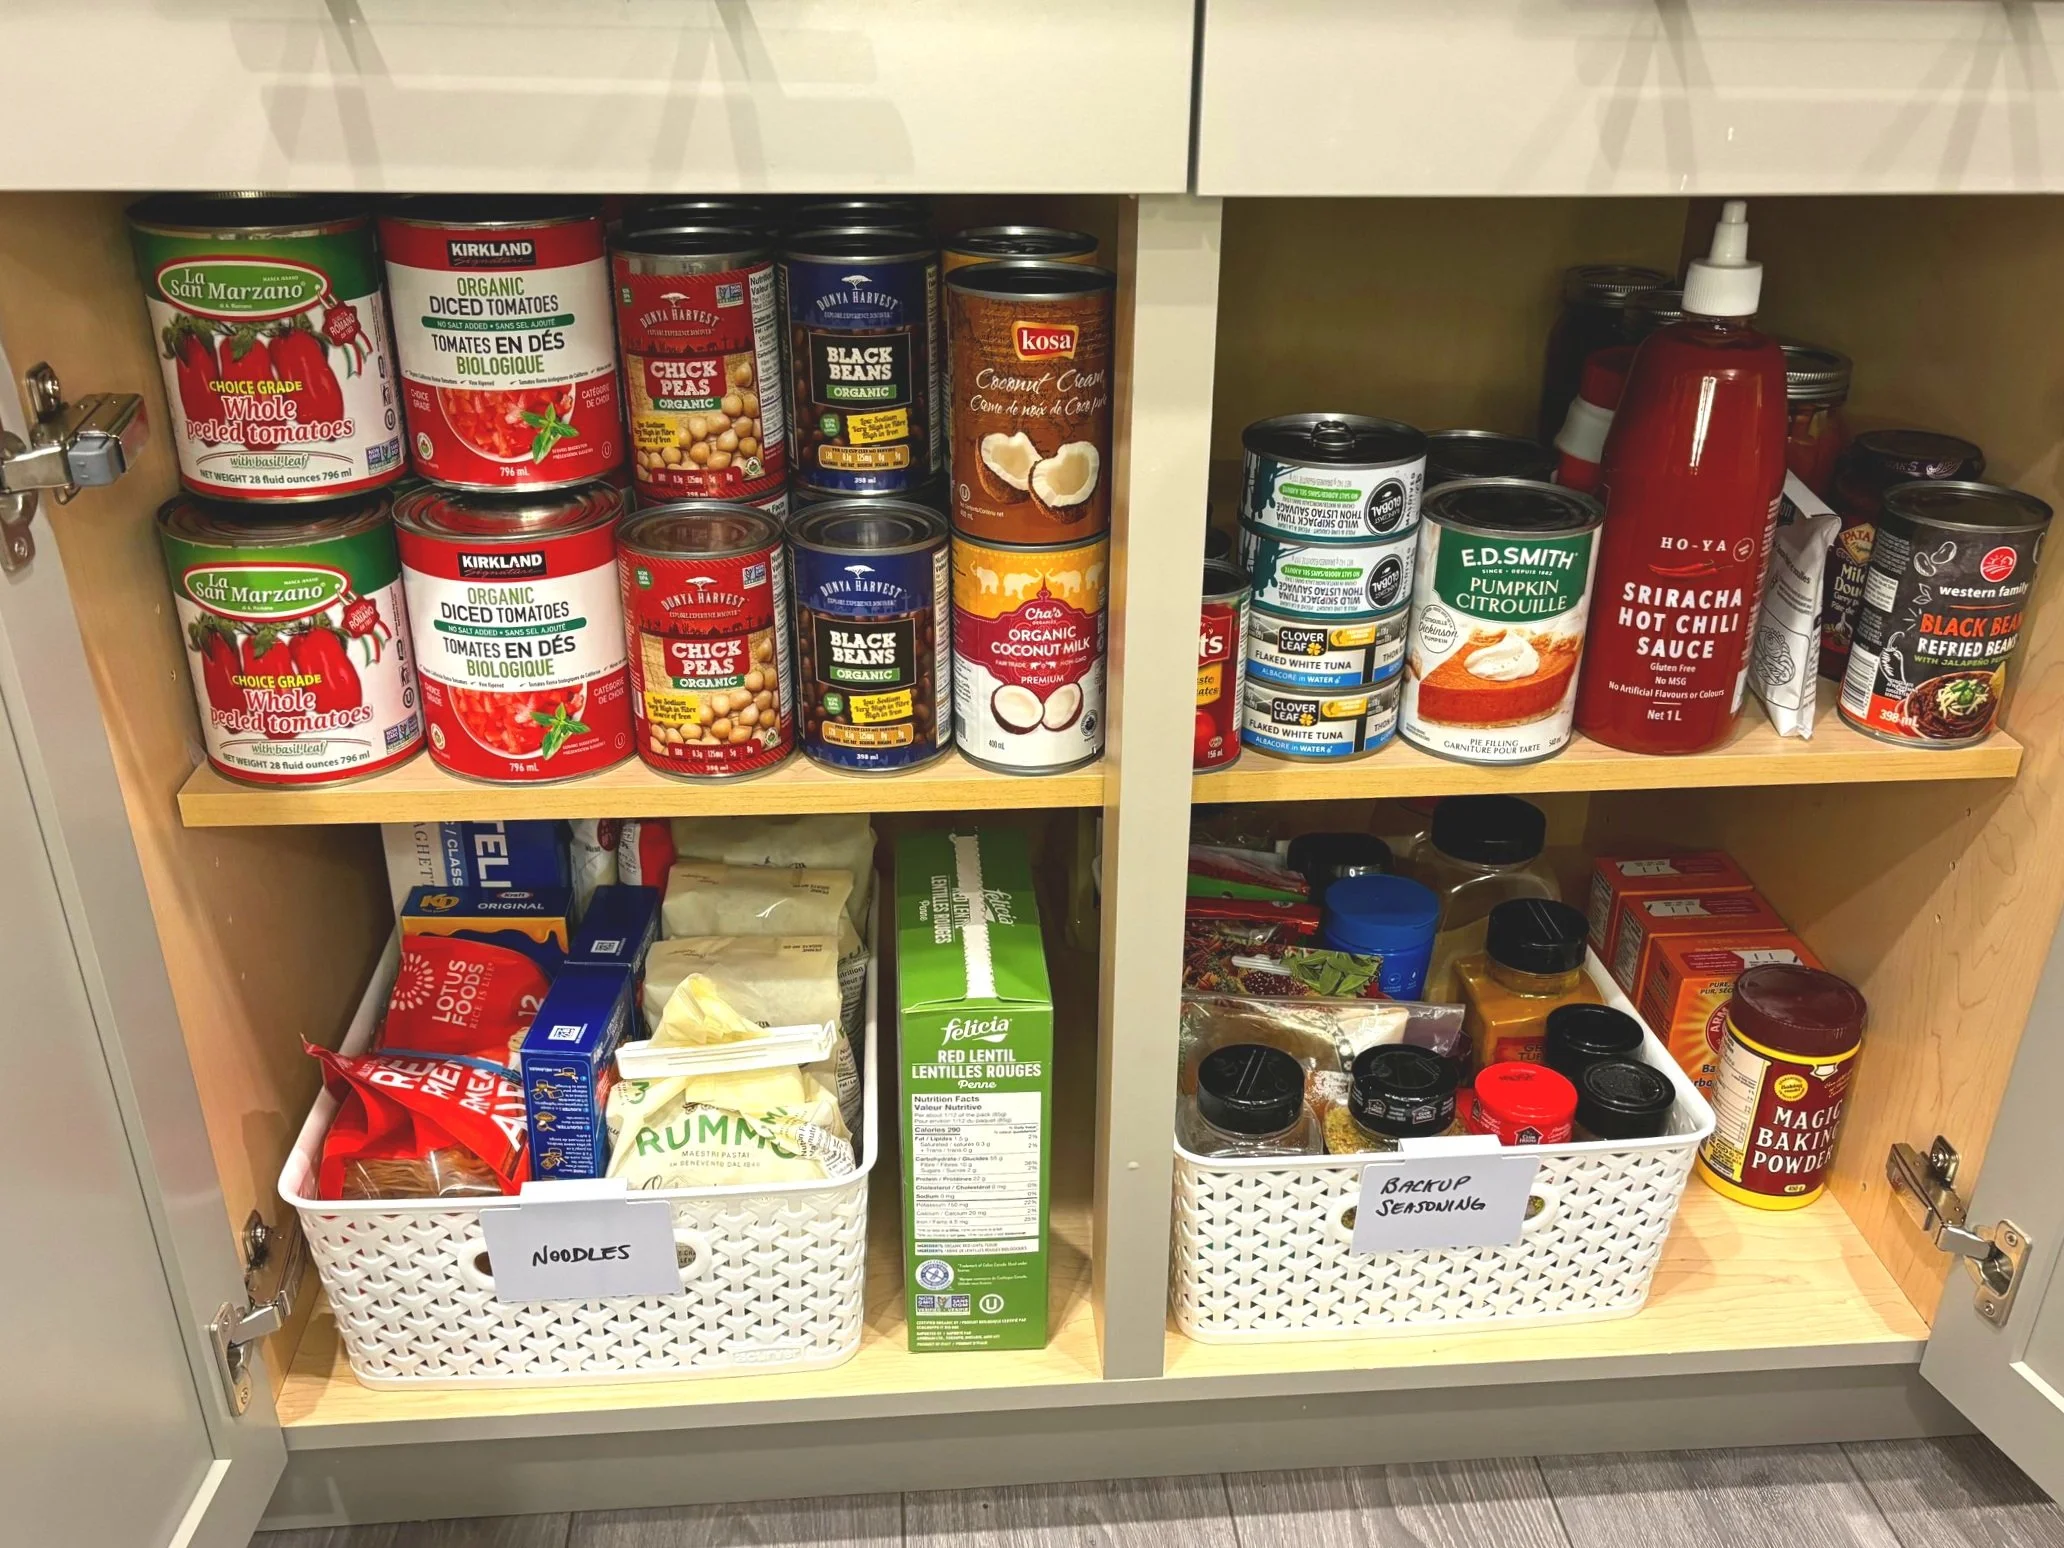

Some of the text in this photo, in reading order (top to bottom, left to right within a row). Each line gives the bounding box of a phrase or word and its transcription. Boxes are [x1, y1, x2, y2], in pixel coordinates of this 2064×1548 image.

[451, 243, 532, 256] KIRKLAND
[184, 269, 205, 284] La
[171, 280, 303, 300] San Marzano
[457, 277, 524, 297] ORGANIC
[430, 295, 558, 316] DICED TOMATOES
[432, 330, 565, 353] TOMATES EN DÉS
[1022, 330, 1071, 350] kosa
[826, 347, 892, 364] BLACK
[456, 355, 544, 375] BIOLOGIQUE
[650, 360, 718, 379] CHICK
[830, 364, 892, 381] BEANS
[209, 381, 303, 394] CHOICE GRADE
[661, 379, 710, 396] PEAS
[976, 368, 1104, 394] Coconut Cream
[834, 388, 889, 398] ORGANIC
[222, 396, 297, 421] Whole
[659, 399, 714, 410] ORGANIC
[187, 419, 354, 444] peeled tomatoes
[1277, 502, 1361, 519] THON LISTAO SAUVAGE
[1371, 496, 1401, 516] GLOBAL
[1276, 512, 1358, 528] WILD SKIPJACK TUNA
[462, 554, 542, 569] KIRKLAND
[1462, 547, 1575, 570] E.D.SMITH
[209, 574, 228, 588] La
[820, 581, 902, 598] DUNYA HARVEST
[1470, 577, 1559, 596] PUMPKIN
[1940, 582, 2029, 598] western family
[196, 583, 323, 602] San Marzano
[467, 587, 534, 605] ORGANIC
[661, 591, 745, 611] DUNYA HARVEST
[1623, 582, 1742, 609] SRIRACHA
[441, 601, 570, 623] DICED TOMATOES
[1456, 593, 1567, 614] CITROUILLE
[1025, 607, 1063, 620] Cha's
[1618, 607, 1739, 634] HOT CHILI
[458, 625, 473, 635] SALT
[475, 628, 498, 636] ADDED
[523, 627, 538, 635] SEL
[1009, 626, 1076, 641] ORGANIC
[1419, 621, 1458, 639] Dickinson
[1920, 614, 1988, 637] BLACK
[830, 630, 896, 649] BLACK
[1281, 631, 1324, 642] CLOVER
[1917, 633, 2018, 657] REFRIED BEANS
[443, 635, 576, 659] TOMATES EN DÉS
[672, 640, 742, 659] CHICK
[991, 636, 1090, 657] COCONUT MILK
[1281, 642, 1306, 651] LEAF
[1636, 637, 1714, 659] SAUCE
[833, 649, 895, 665] BEANS
[1255, 650, 1352, 669] FLAKED WHITE TUNA
[1914, 655, 1989, 666] WITH JALAPEÑO
[467, 659, 555, 678] BIOLOGIQUE
[683, 659, 735, 676] PEAS
[837, 669, 893, 680] ORGANIC
[1262, 668, 1297, 681] ALBACORE
[1307, 675, 1333, 684] WATER
[1650, 662, 1696, 673] Gluten Free
[232, 674, 322, 688] CHOICE GRADE
[680, 677, 738, 688] ORGANIC
[1021, 675, 1064, 684] PREMIUM
[1655, 676, 1686, 686] No MSG
[1609, 681, 1619, 690] No
[1620, 684, 1653, 697] Artificial
[1655, 689, 1688, 699] Flavours
[1699, 688, 1725, 698] Colours
[244, 688, 315, 712] Whole
[210, 705, 372, 733] peeled tomatoes
[1647, 709, 1682, 721] Net 1 L
[1879, 709, 1919, 727] 398 mL
[251, 743, 274, 754] with
[1444, 741, 1540, 754] GARNITURE POUR TARTE
[1470, 738, 1519, 748] PIE FILLING
[223, 751, 370, 769] NET WEIGHT 28 fluid ounces 796 ml
[510, 763, 525, 772] 796
[477, 902, 544, 910] ORIGINAL
[432, 960, 466, 1023] LOTUS
[451, 964, 484, 1026] FOODS
[1710, 1007, 1729, 1032] ARM
[941, 1016, 1012, 1046] felicia
[938, 1049, 1016, 1062] RED LENTIL
[912, 1064, 1041, 1079] LENTILLES ROUGES
[957, 1079, 996, 1089] Penne
[1773, 1099, 1842, 1130] MAGIC
[1756, 1121, 1840, 1151] BAKING
[681, 1150, 719, 1158] MAESTRI
[1751, 1144, 1833, 1173] POWDER
[1380, 1176, 1471, 1195] BACKUP
[1375, 1196, 1486, 1217] SEASONING
[532, 1245, 631, 1266] NOODLES
